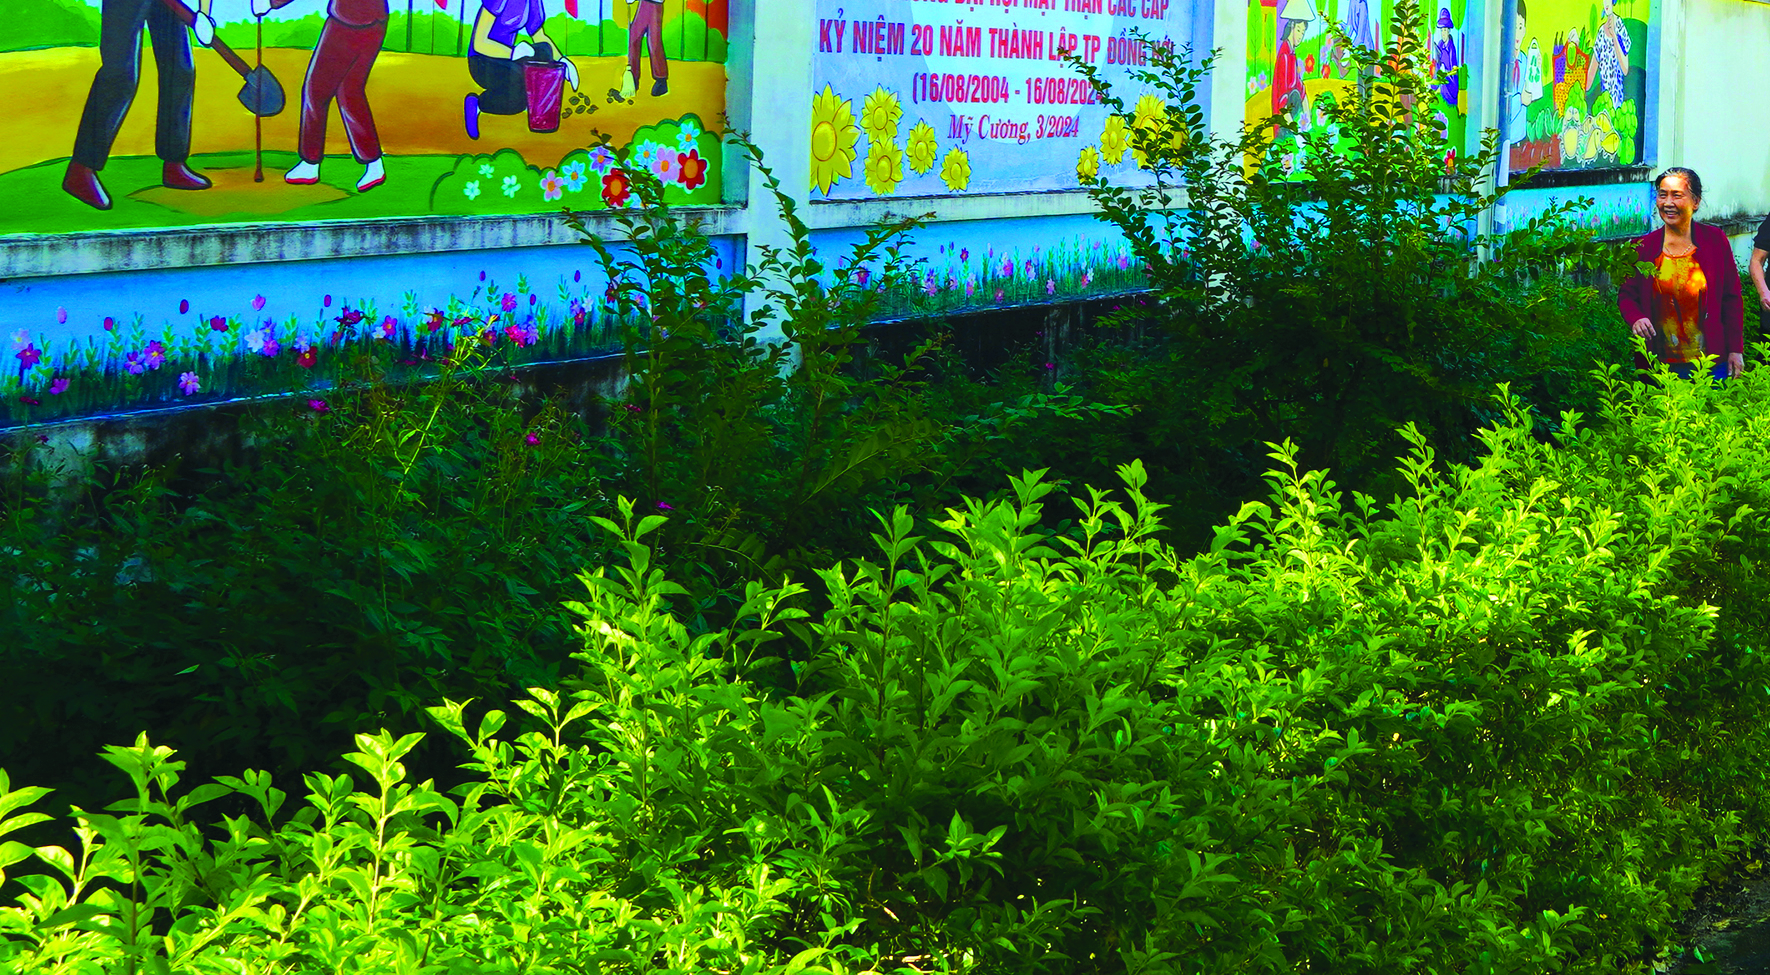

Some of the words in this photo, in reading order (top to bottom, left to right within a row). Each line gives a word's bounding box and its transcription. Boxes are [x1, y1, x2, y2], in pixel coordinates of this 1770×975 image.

[819, 8, 846, 53] KỶ
[853, 14, 905, 61] NIỆM
[910, 24, 934, 56] 20
[939, 18, 981, 58] NĂM
[989, 22, 1044, 61] THÀNH
[1049, 26, 1078, 68] LẬP
[1083, 34, 1101, 64] TP
[1107, 28, 1147, 67] ĐỒNG
[913, 72, 1009, 104] (16/08/2004
[947, 115, 974, 144] Mỹ
[978, 115, 1031, 145] Cương,
[1036, 114, 1080, 139] 3/2024
